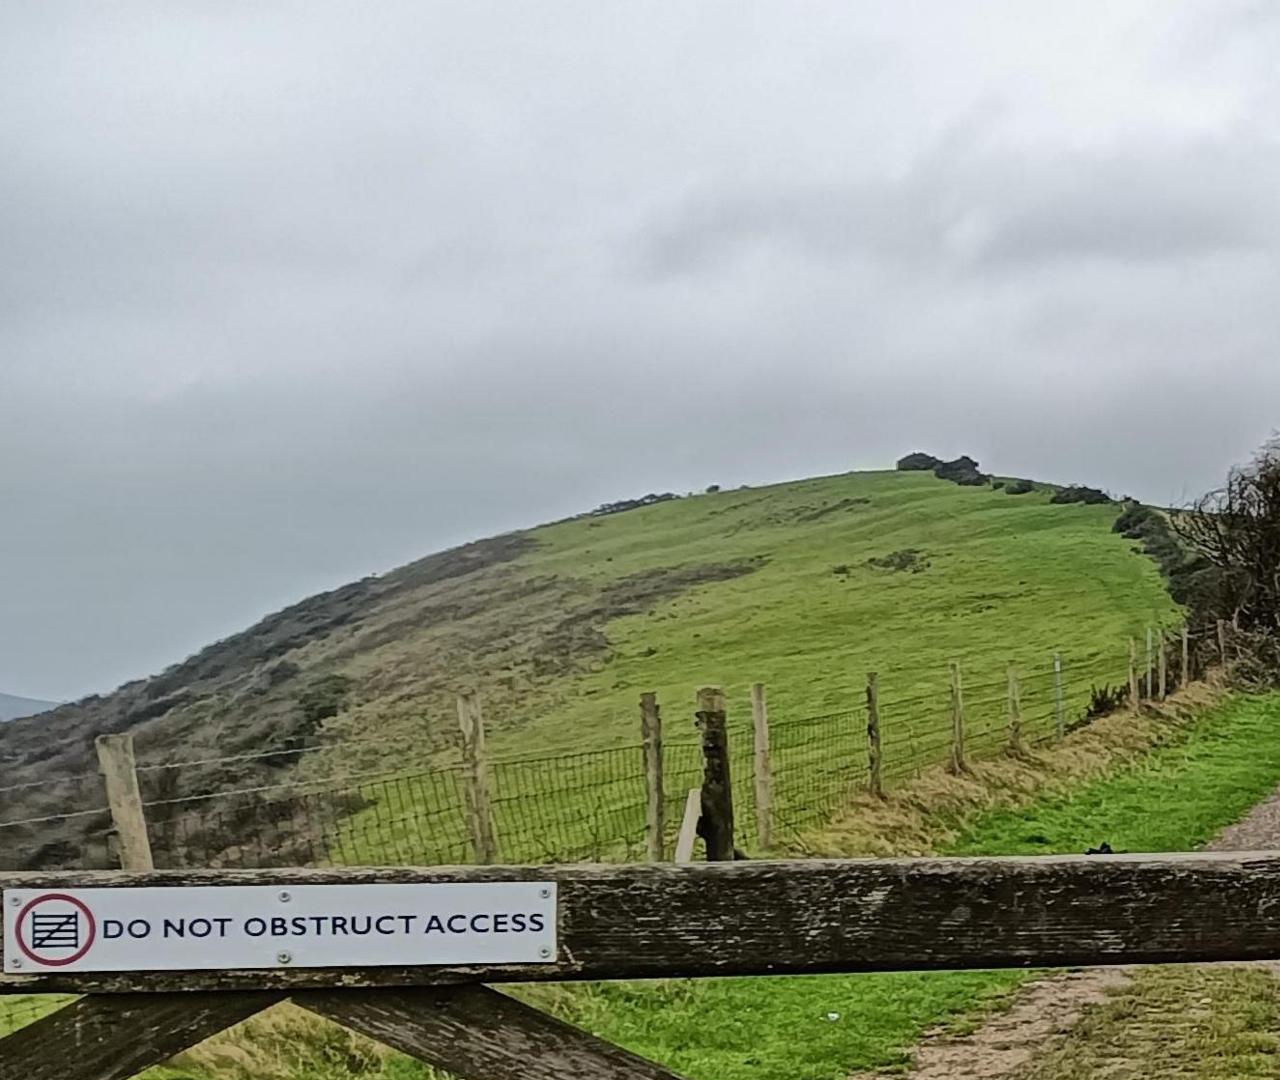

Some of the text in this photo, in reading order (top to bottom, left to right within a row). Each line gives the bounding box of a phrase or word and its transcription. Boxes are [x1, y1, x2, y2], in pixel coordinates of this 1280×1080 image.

[103, 913, 544, 940] DO NOT OBSTRUCT ACCESS
